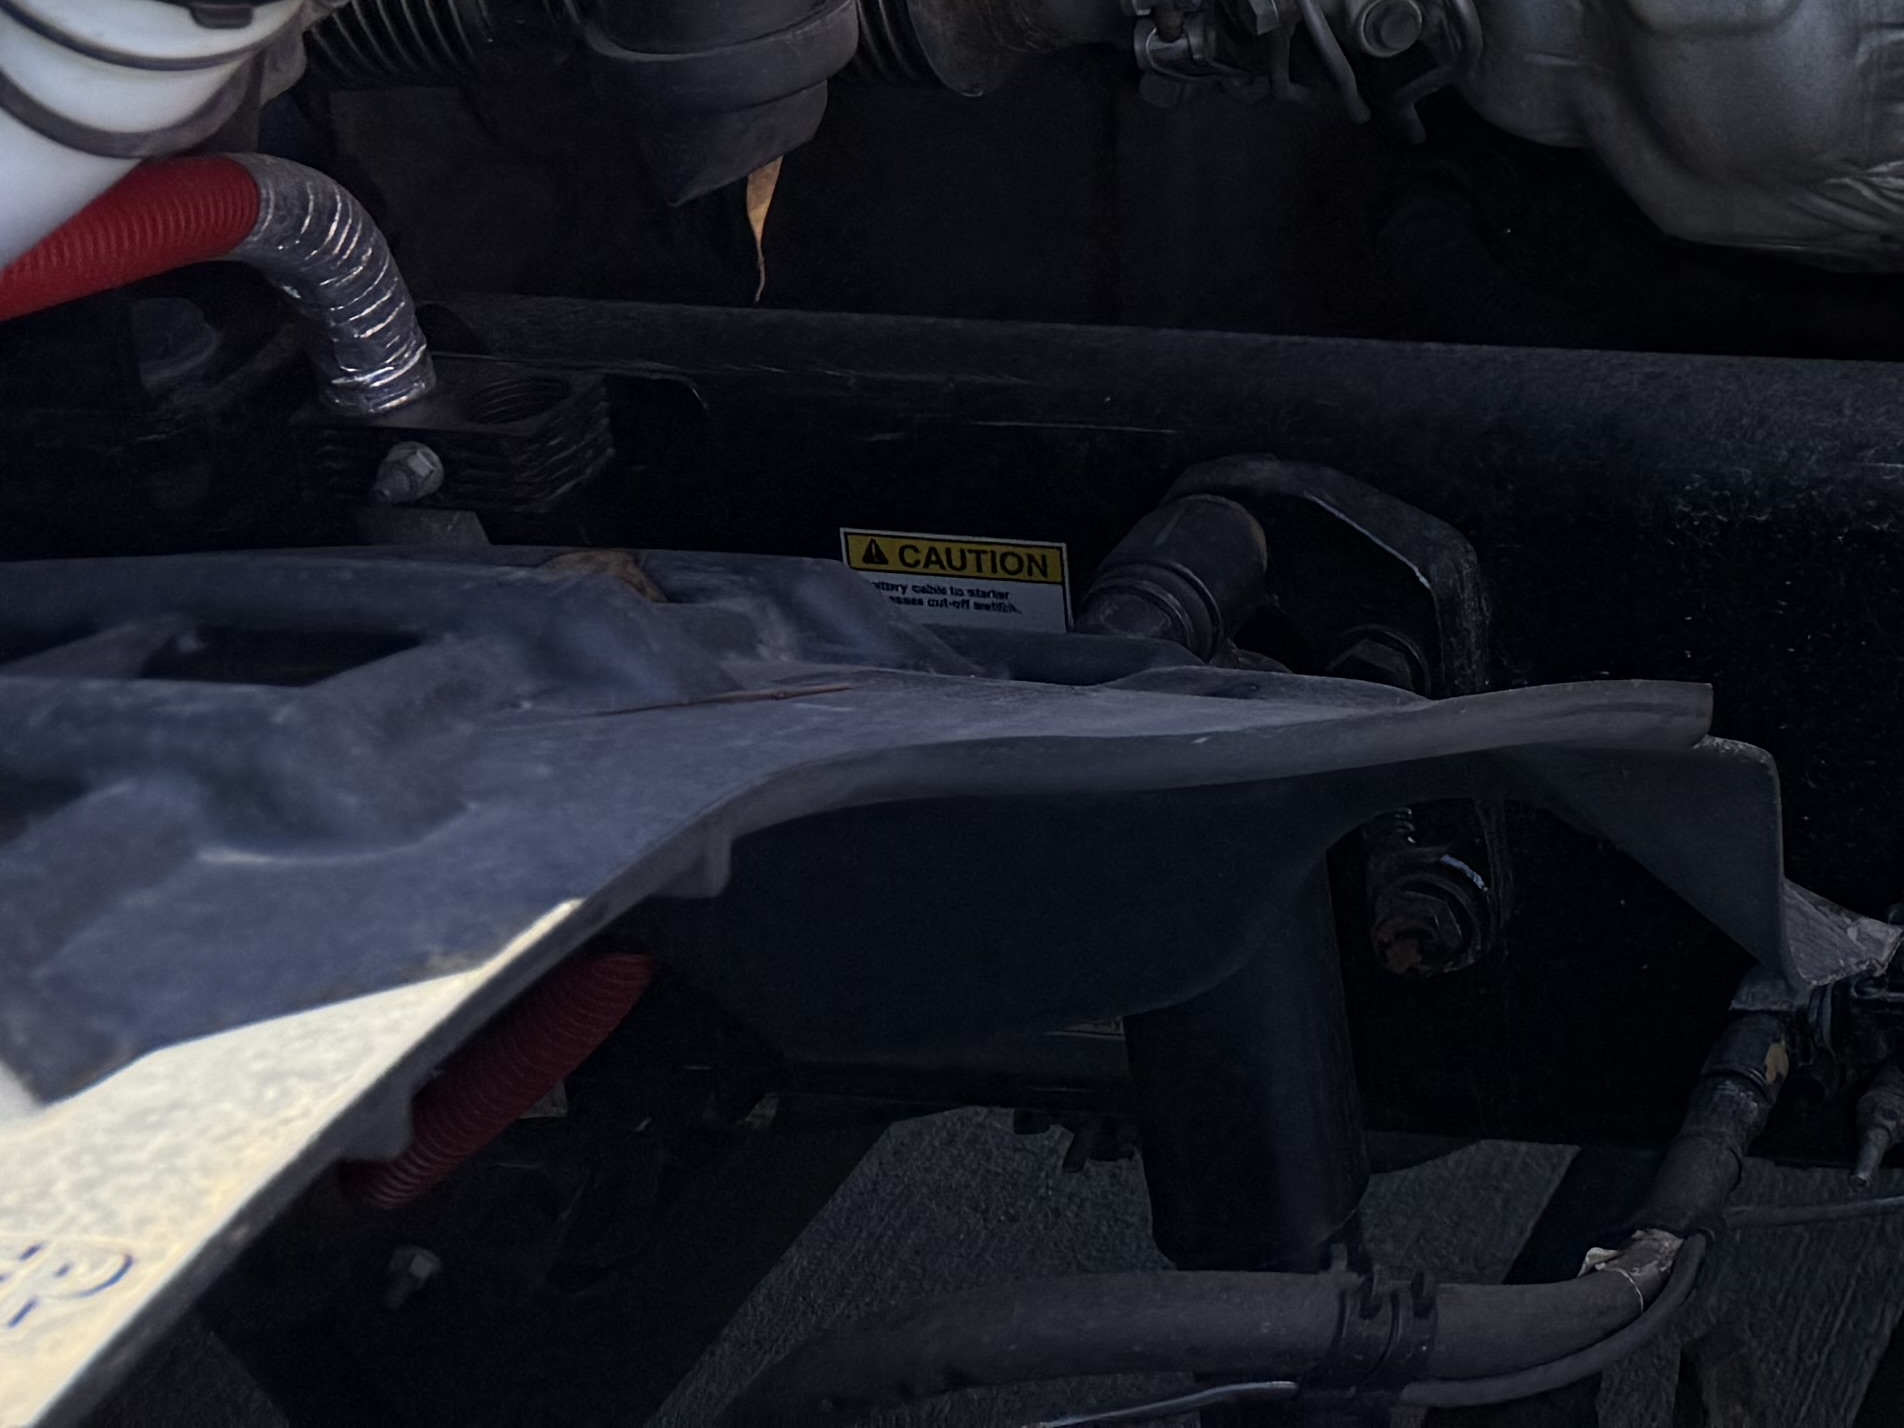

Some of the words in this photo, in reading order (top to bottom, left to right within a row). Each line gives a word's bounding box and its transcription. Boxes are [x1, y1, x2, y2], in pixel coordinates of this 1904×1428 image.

[899, 543, 1048, 579] CAUTION
[967, 587, 1010, 600] starter
[928, 597, 971, 609] cut-off
